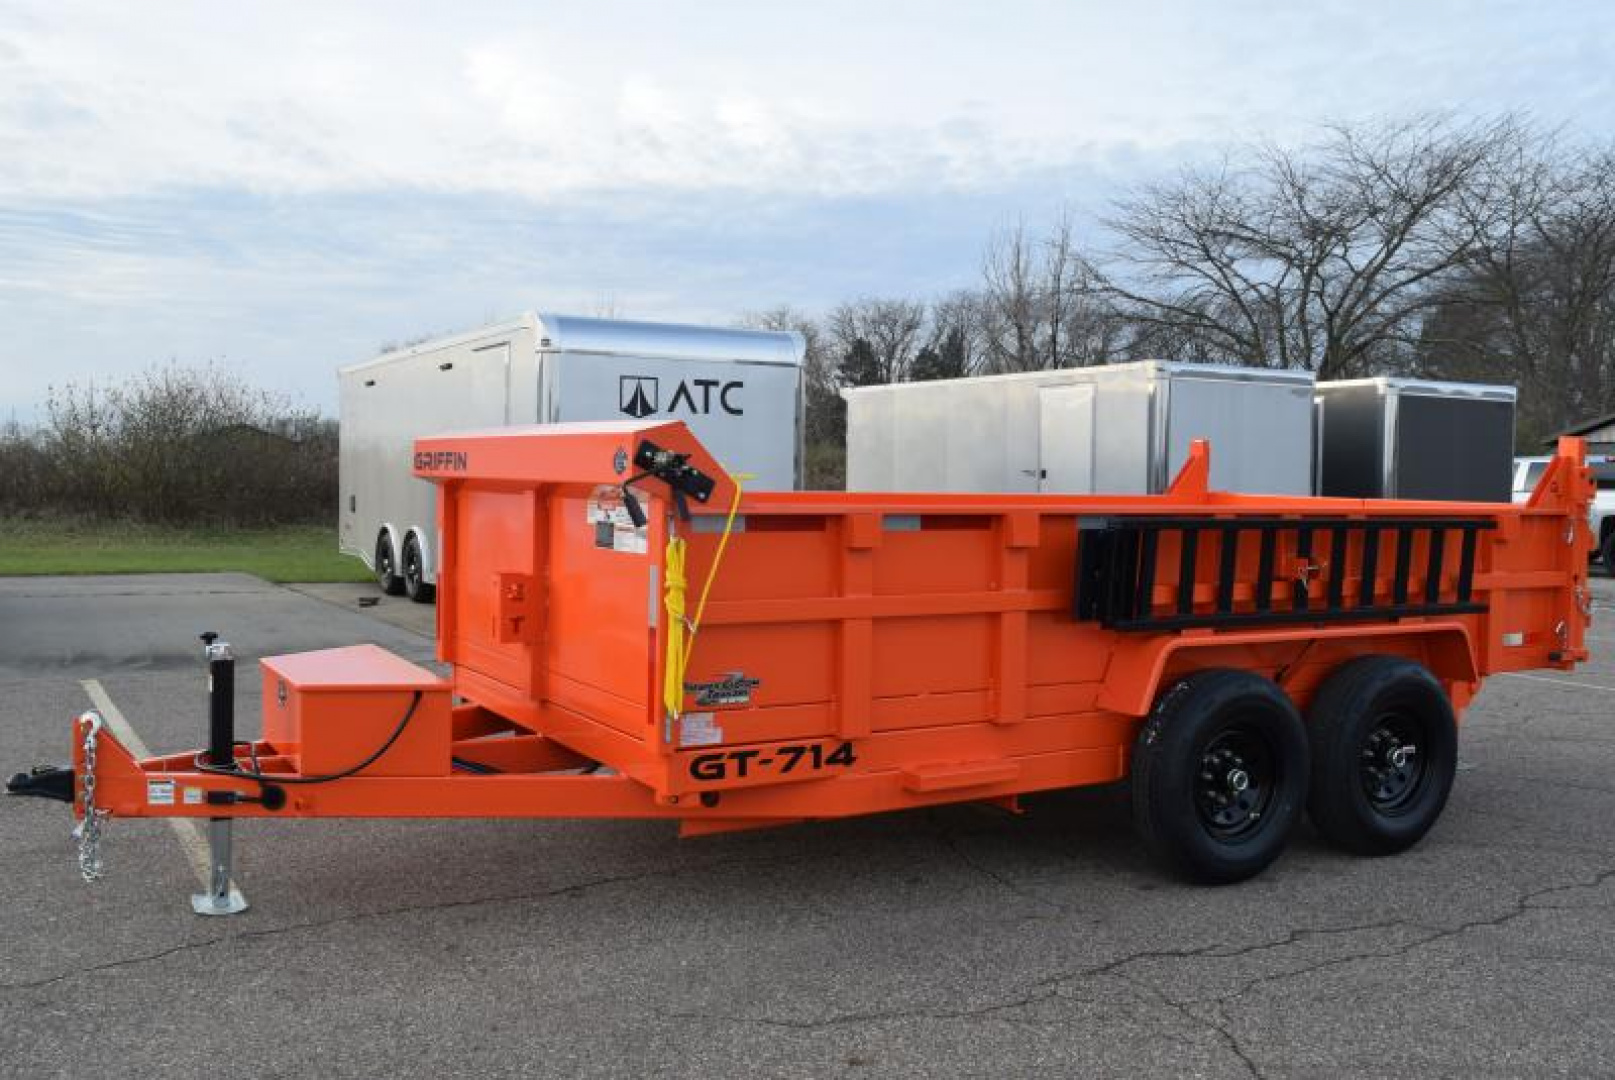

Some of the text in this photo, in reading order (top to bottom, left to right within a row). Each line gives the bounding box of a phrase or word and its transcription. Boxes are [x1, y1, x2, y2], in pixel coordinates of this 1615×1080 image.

[668, 379, 743, 415] ATC
[414, 451, 467, 471] GRIFFIN
[690, 742, 857, 779] GT-714
